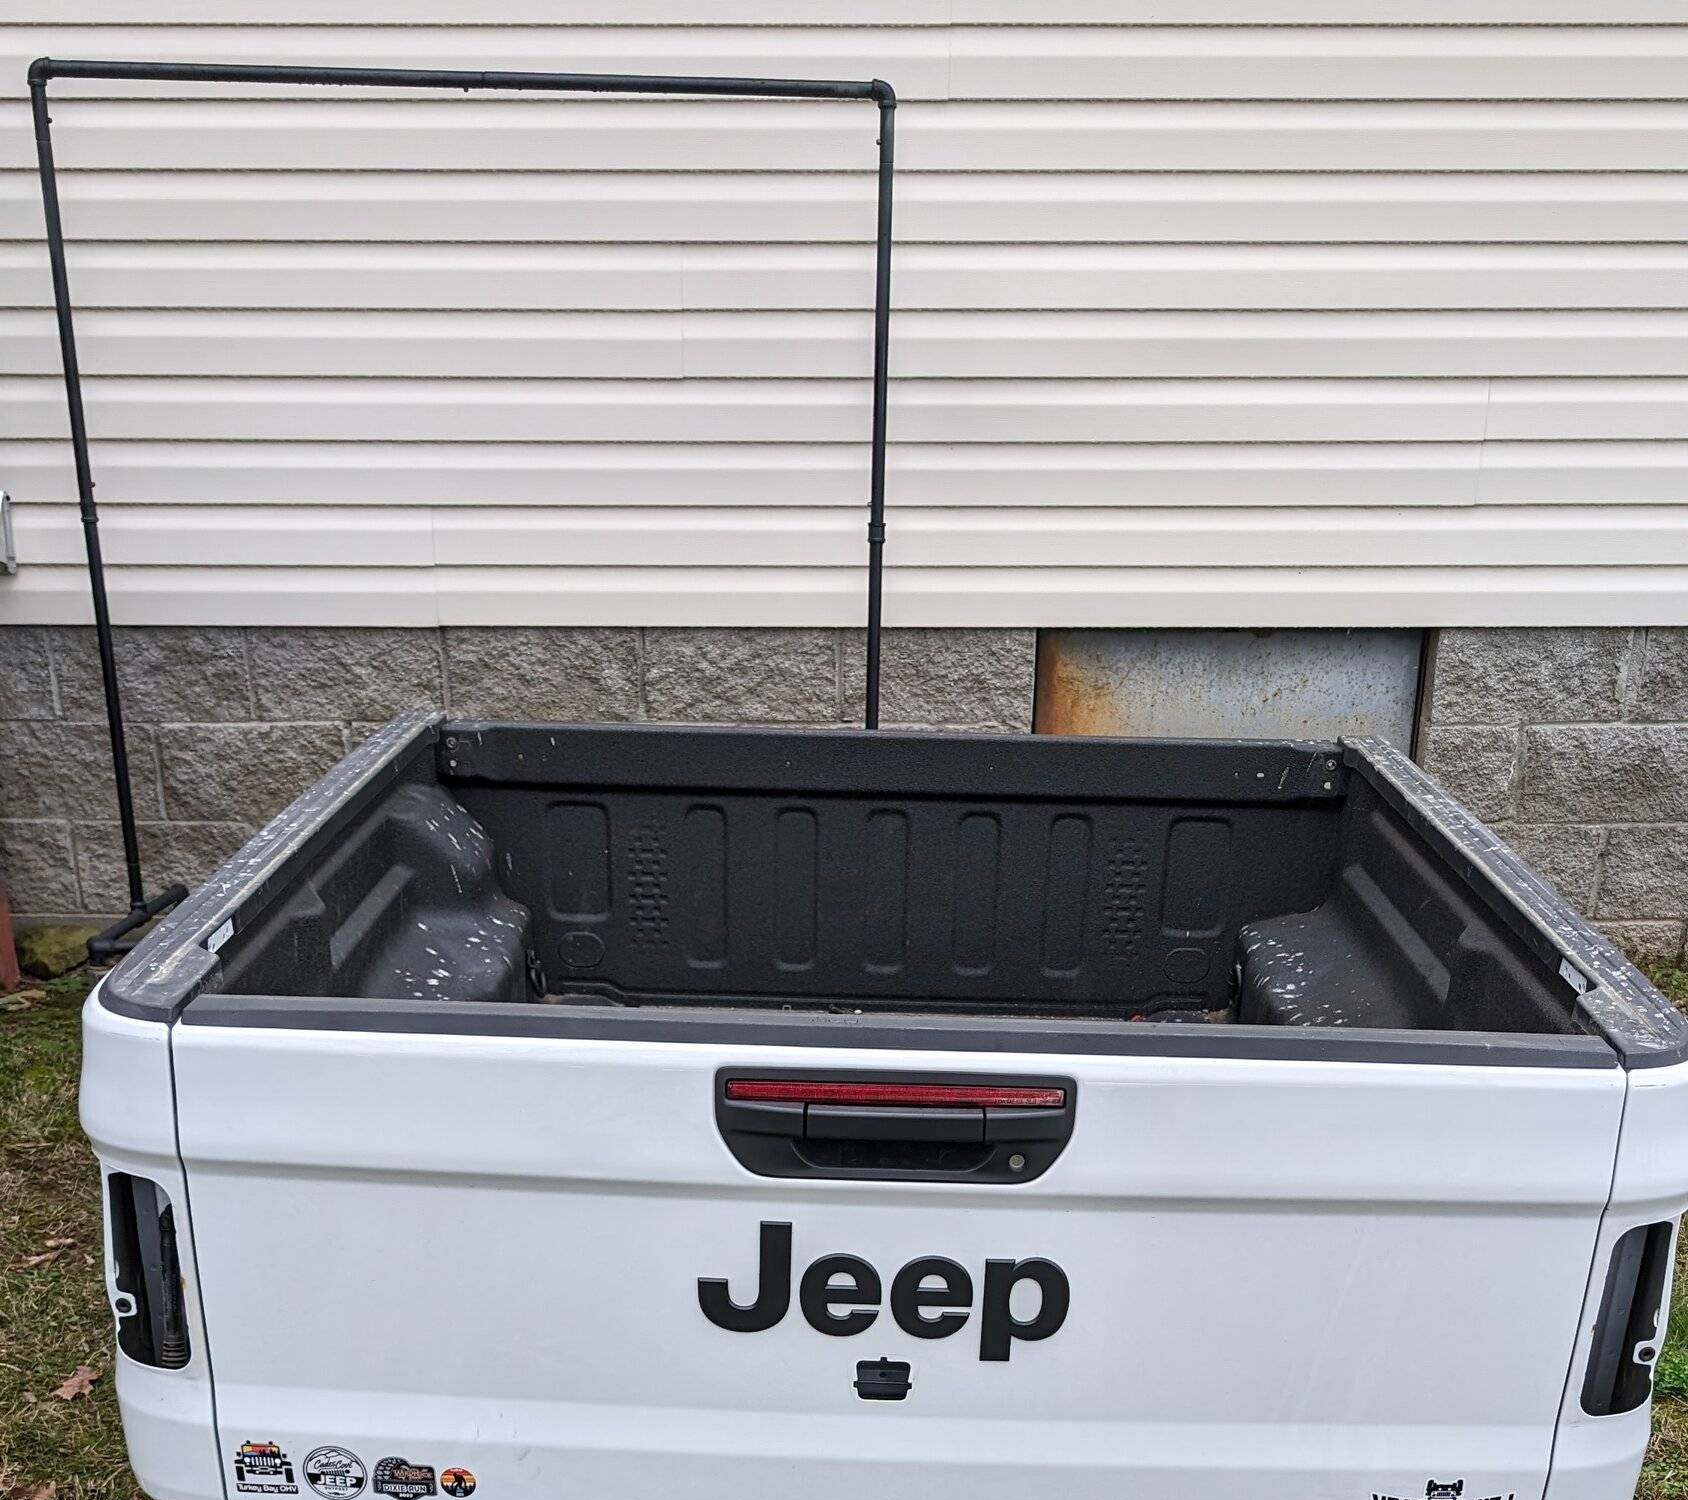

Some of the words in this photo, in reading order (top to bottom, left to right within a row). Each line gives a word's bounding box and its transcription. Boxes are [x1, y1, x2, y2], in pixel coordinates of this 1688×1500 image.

[697, 1220, 1071, 1362] Jeep
[316, 1474, 358, 1488] JEEP
[237, 1483, 262, 1493] Turkey
[262, 1484, 279, 1493] Bay
[382, 1483, 407, 1493] DIXIE
[407, 1484, 428, 1494] RUN
